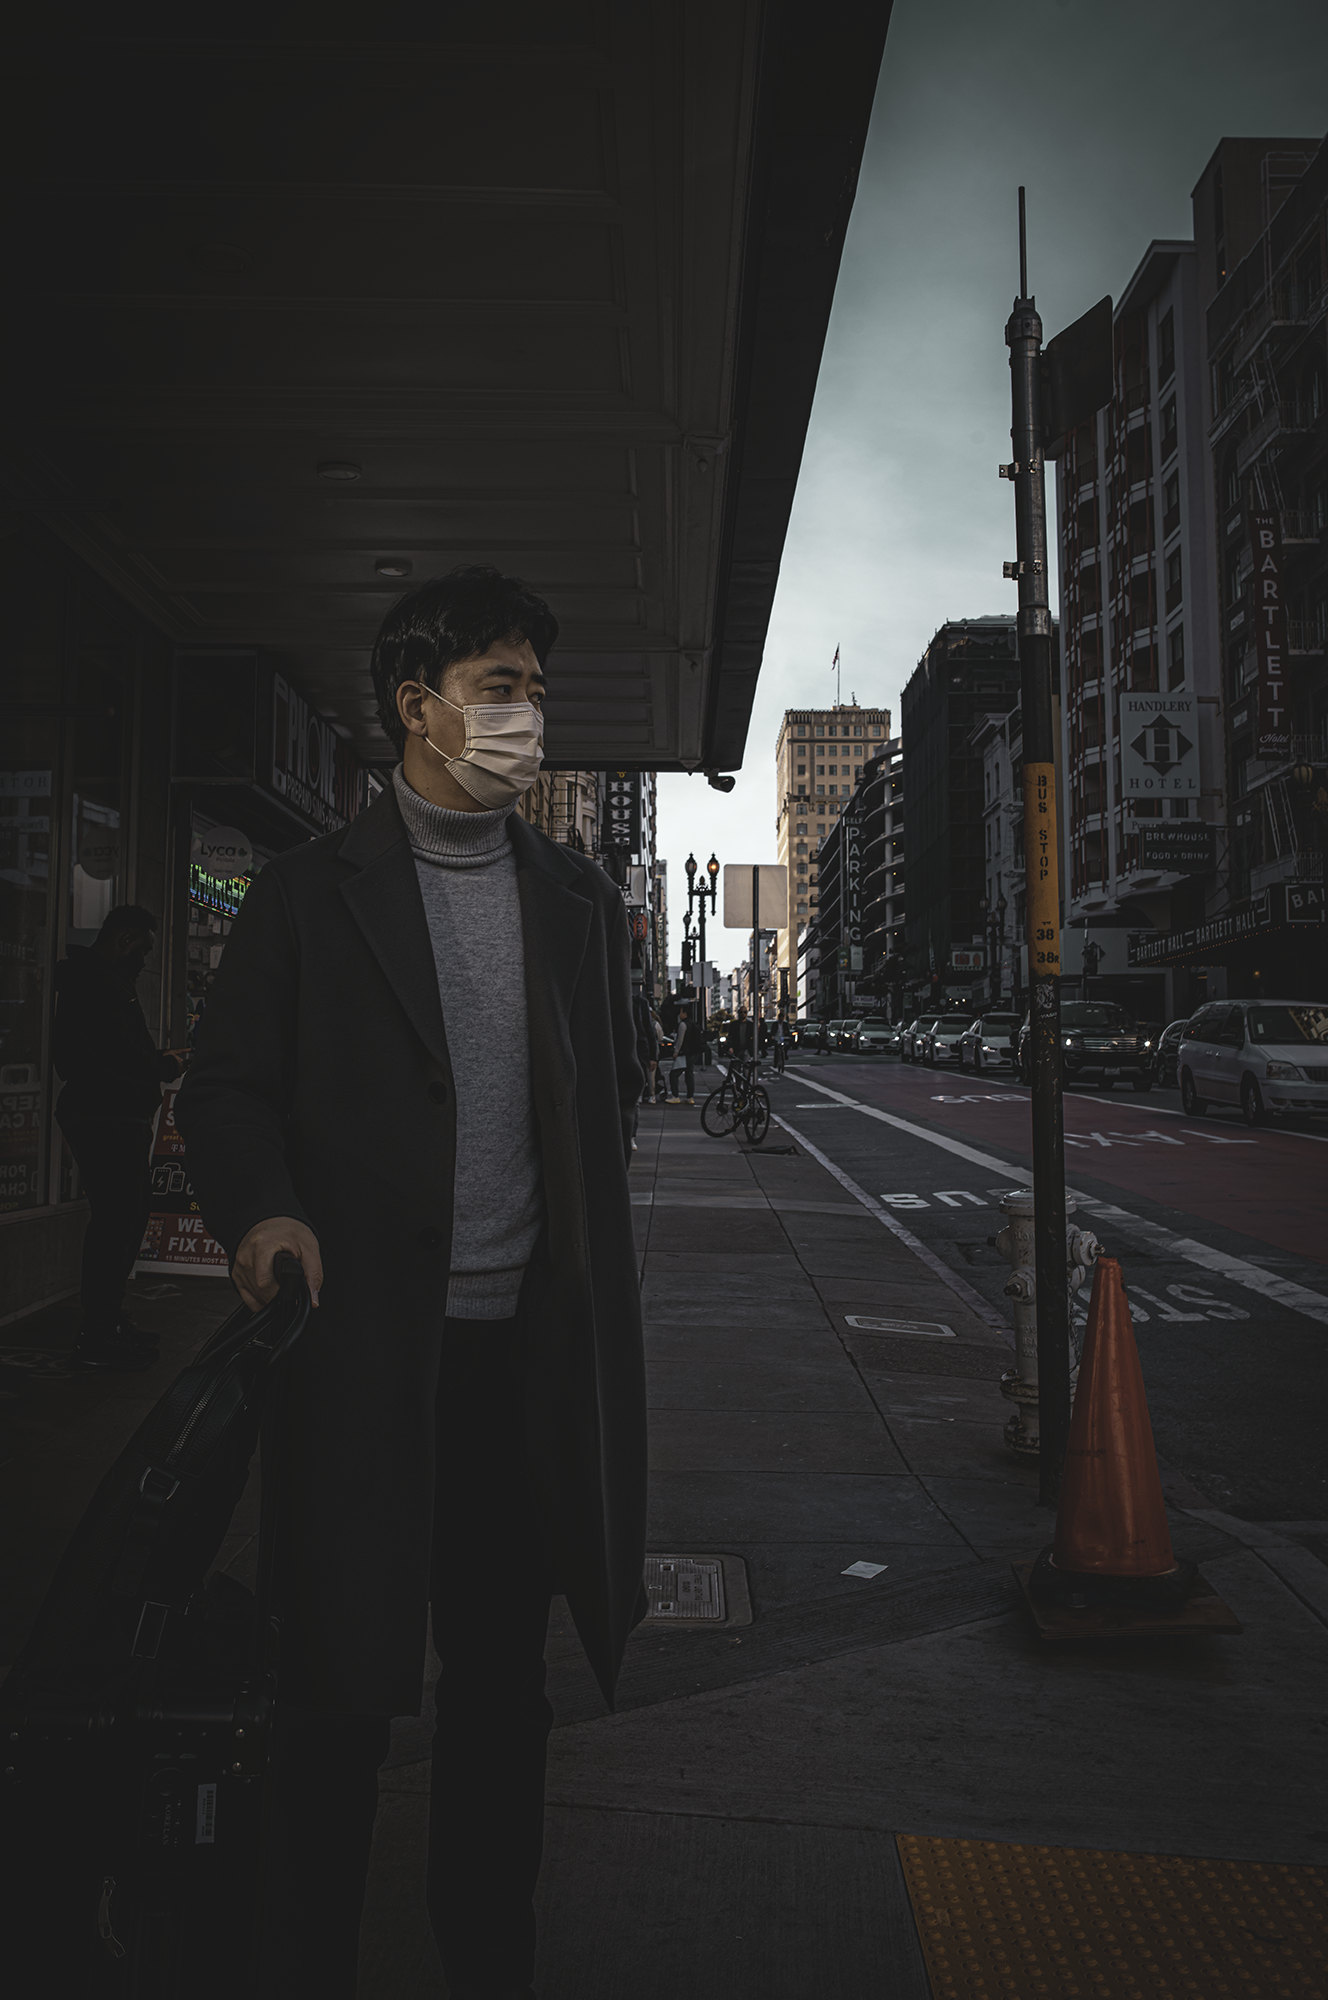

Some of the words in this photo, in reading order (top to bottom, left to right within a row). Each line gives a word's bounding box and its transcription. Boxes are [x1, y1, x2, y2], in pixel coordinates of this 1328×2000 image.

[1255, 517, 1275, 525] THE
[1259, 529, 1284, 727] BARTLETT
[1128, 701, 1192, 712] HANDLERY
[1259, 733, 1290, 744] Hotel
[287, 685, 337, 810] PHONE
[1129, 778, 1196, 789] HOTEL
[286, 772, 312, 815] PREPAID
[1038, 775, 1048, 814] BUS
[1145, 832, 1210, 841] BREWHOUSE
[200, 843, 236, 858] Lyca
[1039, 829, 1049, 881] STOP
[1146, 852, 1171, 860] FOOD
[1181, 852, 1210, 860] DRINK
[849, 827, 861, 941] PARKING
[1036, 929, 1054, 941] 38
[1196, 918, 1233, 944] BARTLETT
[1236, 910, 1257, 933] HALL
[1136, 939, 1166, 961] BARTLETT
[1168, 934, 1184, 952] HALL
[177, 1217, 204, 1233] WE
[167, 1237, 197, 1253] FIX
[172, 1255, 201, 1263] MINUTES
[162, 1803, 172, 1846] KORELAN
